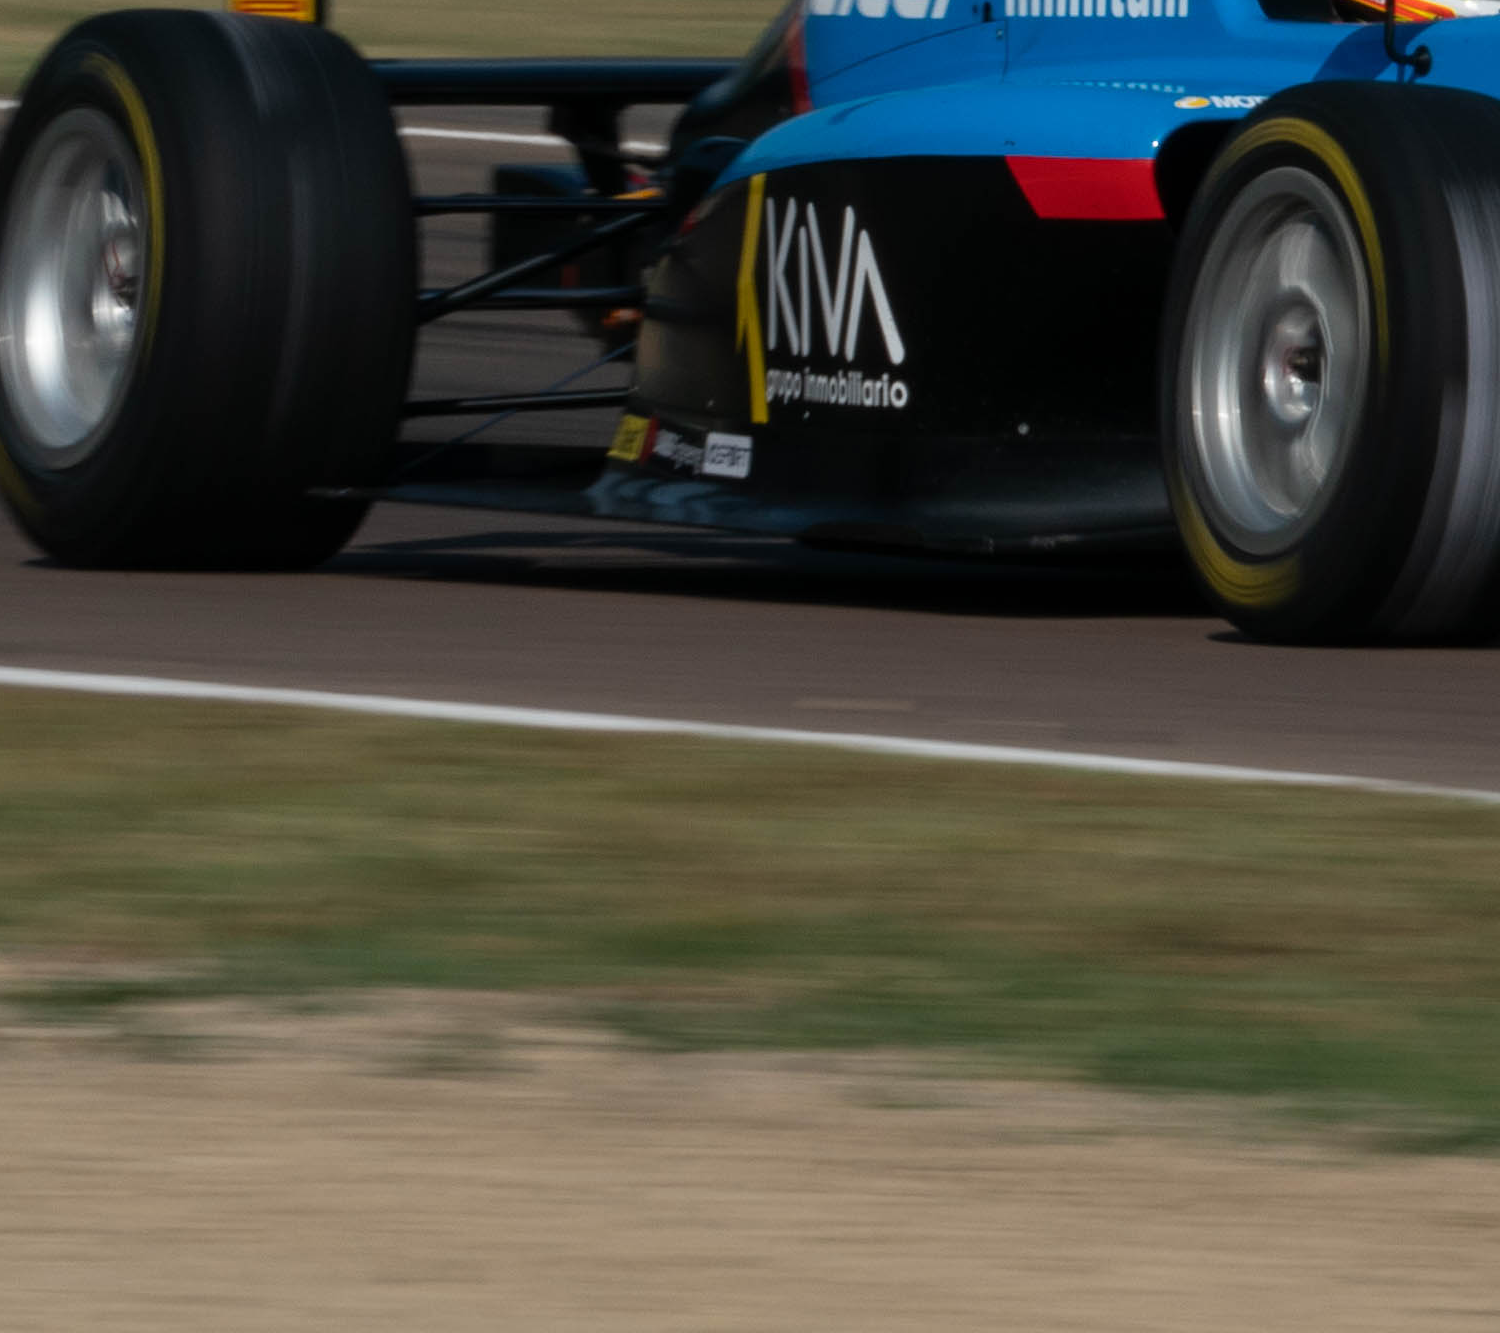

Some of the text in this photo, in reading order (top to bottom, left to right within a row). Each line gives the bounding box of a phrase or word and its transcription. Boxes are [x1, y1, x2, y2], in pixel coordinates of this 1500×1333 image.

[766, 197, 905, 365] KIVA
[766, 367, 908, 407] grupo inmobiliario
